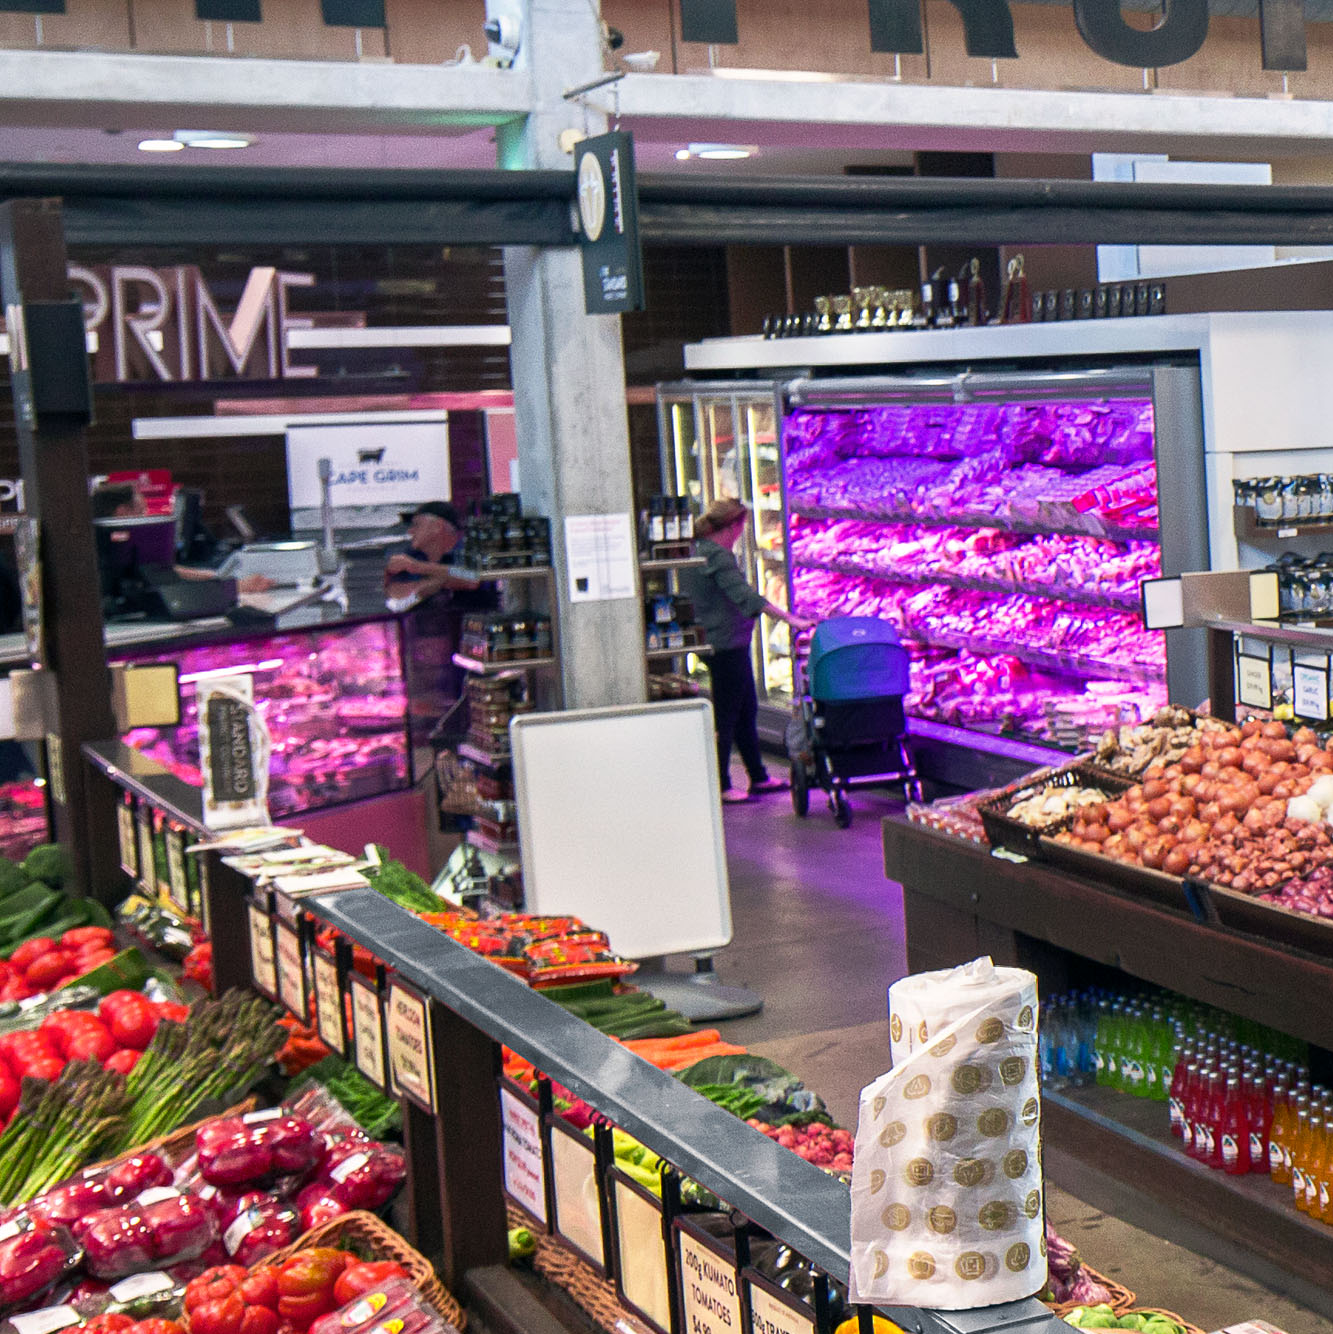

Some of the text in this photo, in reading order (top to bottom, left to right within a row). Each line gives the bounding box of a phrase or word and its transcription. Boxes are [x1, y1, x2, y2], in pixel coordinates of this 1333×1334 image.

[685, 1248, 735, 1296] 200g KUMATO
[691, 1283, 732, 1327] TOMATOES
